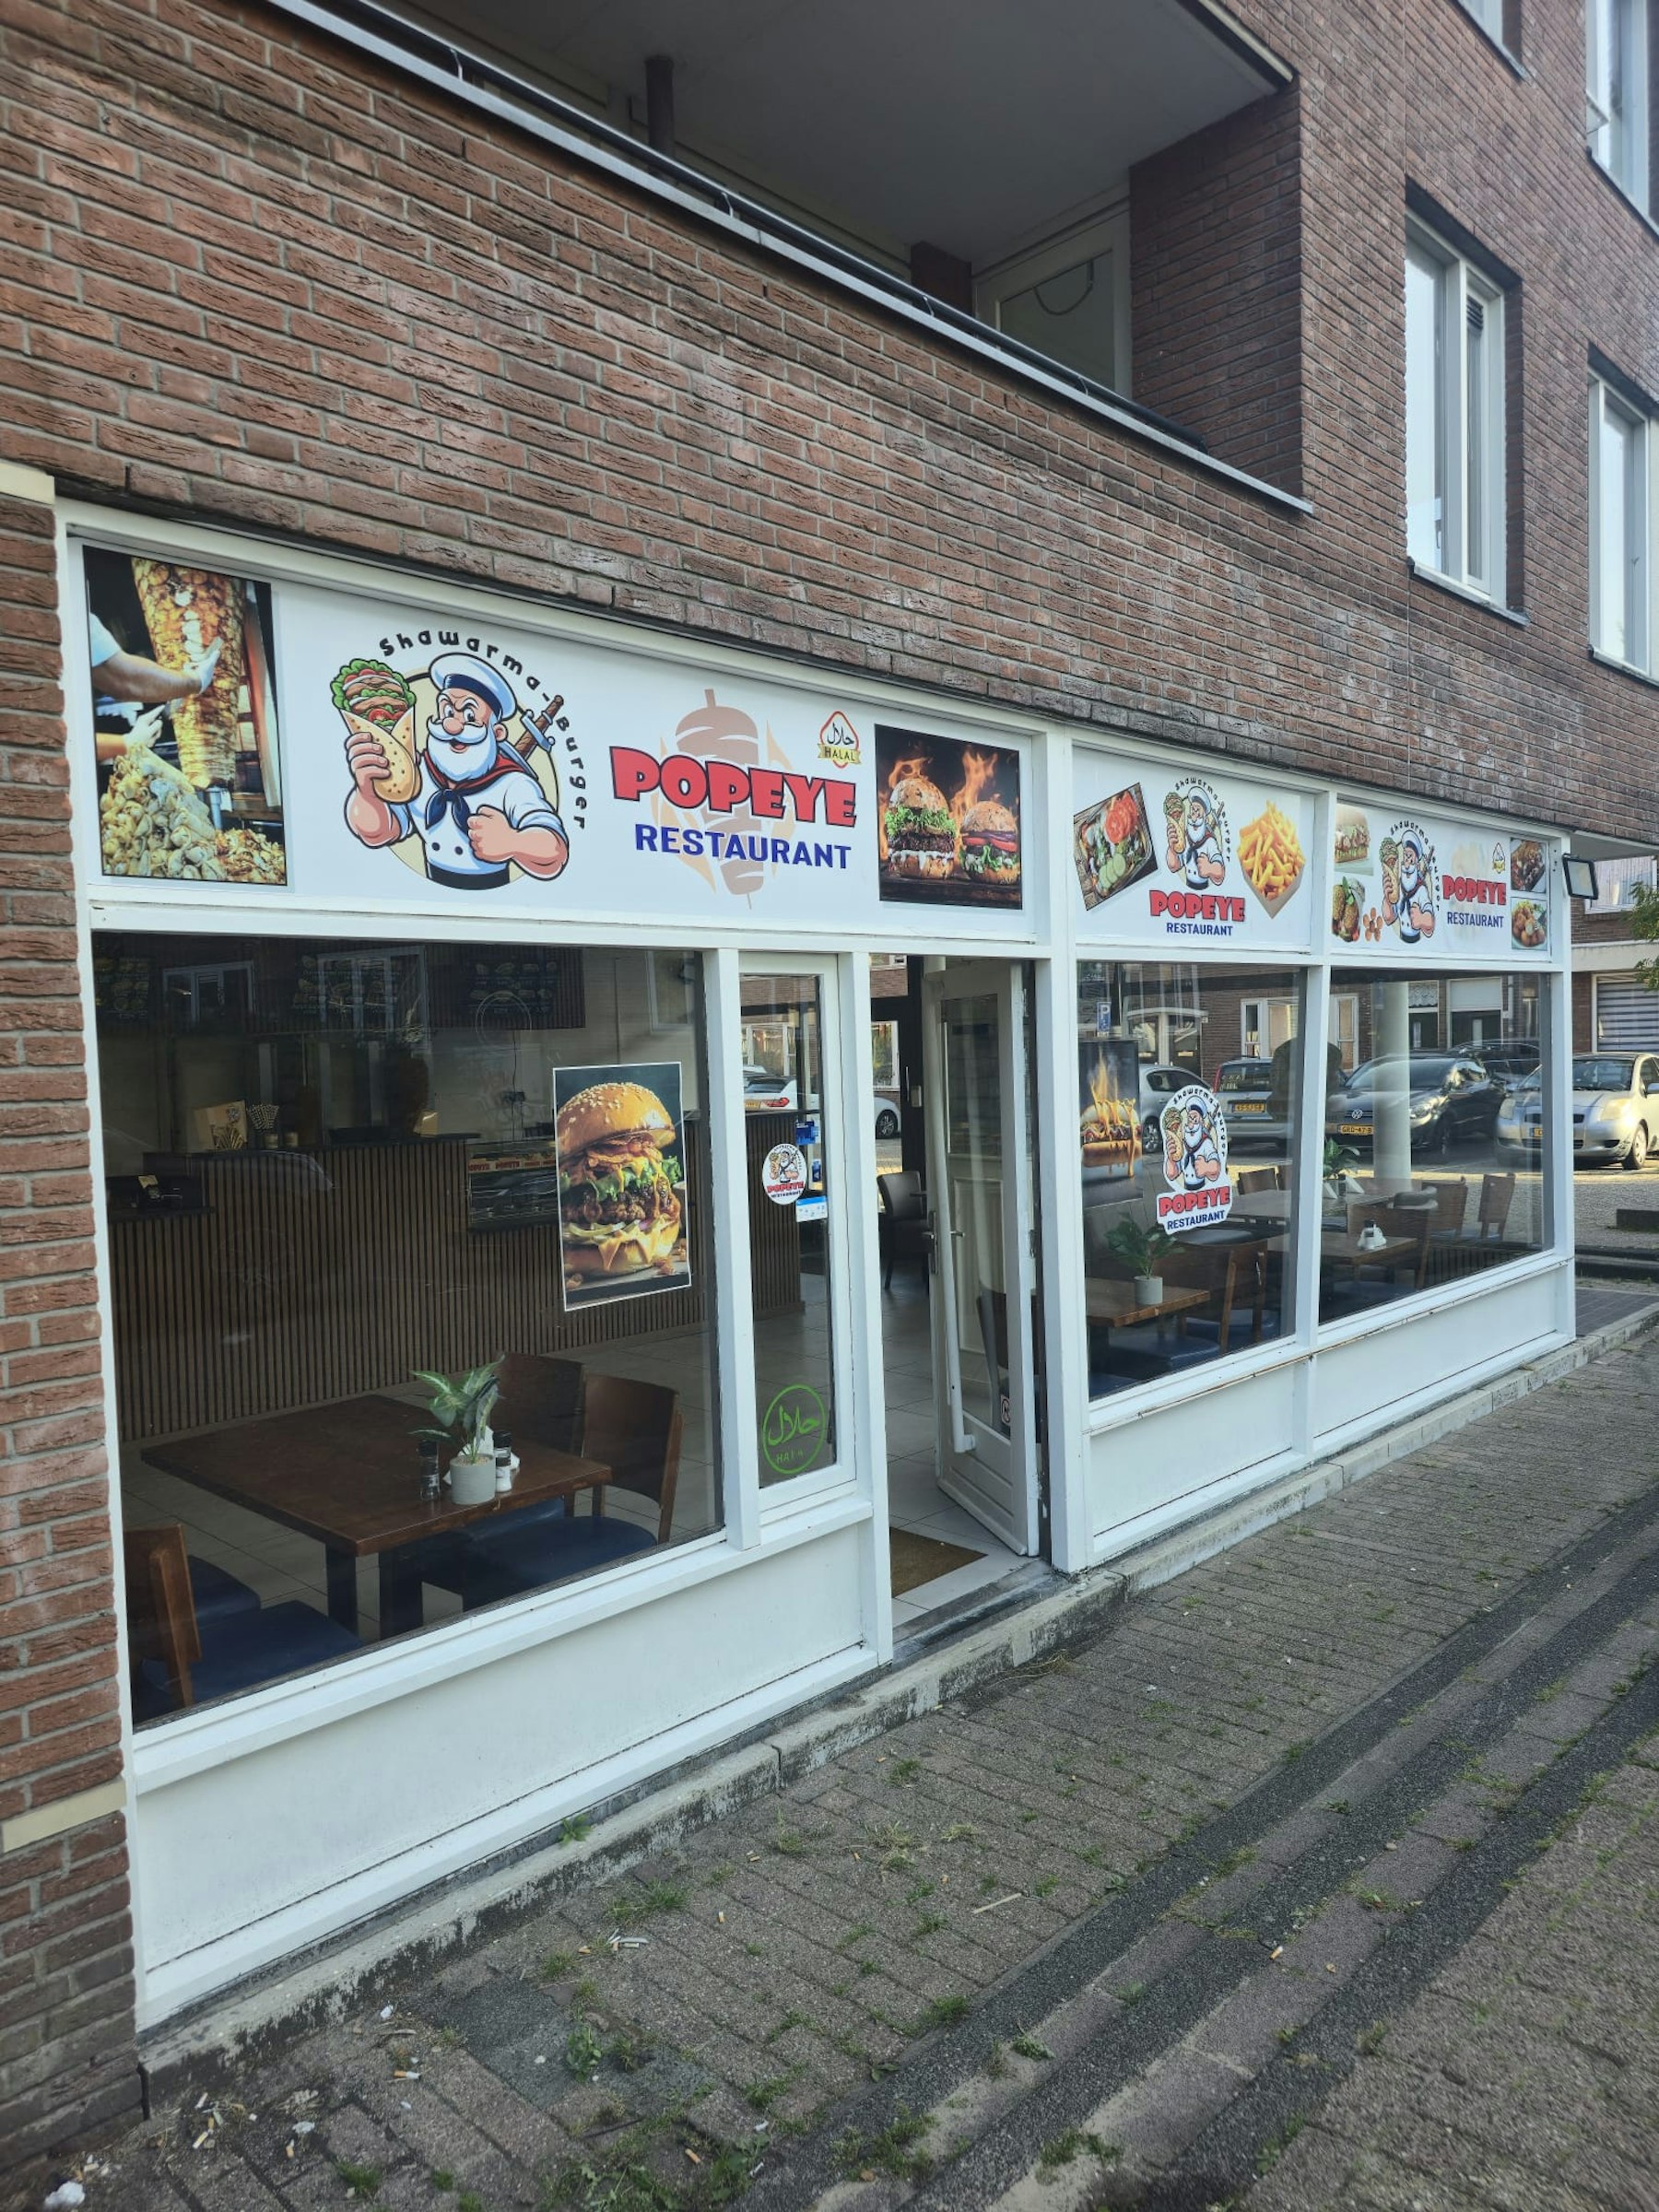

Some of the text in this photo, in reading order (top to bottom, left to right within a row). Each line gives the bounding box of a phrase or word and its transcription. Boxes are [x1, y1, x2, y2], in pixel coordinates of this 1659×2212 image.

[824, 746, 856, 762] HALAL
[609, 746, 857, 828] POPEYE
[635, 823, 852, 869] RESTAURANT
[1441, 874, 1507, 906] POPEYE
[1149, 889, 1245, 923] POPEYE
[1447, 911, 1504, 929] RESTAURANT
[1166, 922, 1234, 936] RESTAURANT
[1159, 1186, 1230, 1217] POPEYE
[1167, 1210, 1226, 1230] RESTAURANT
